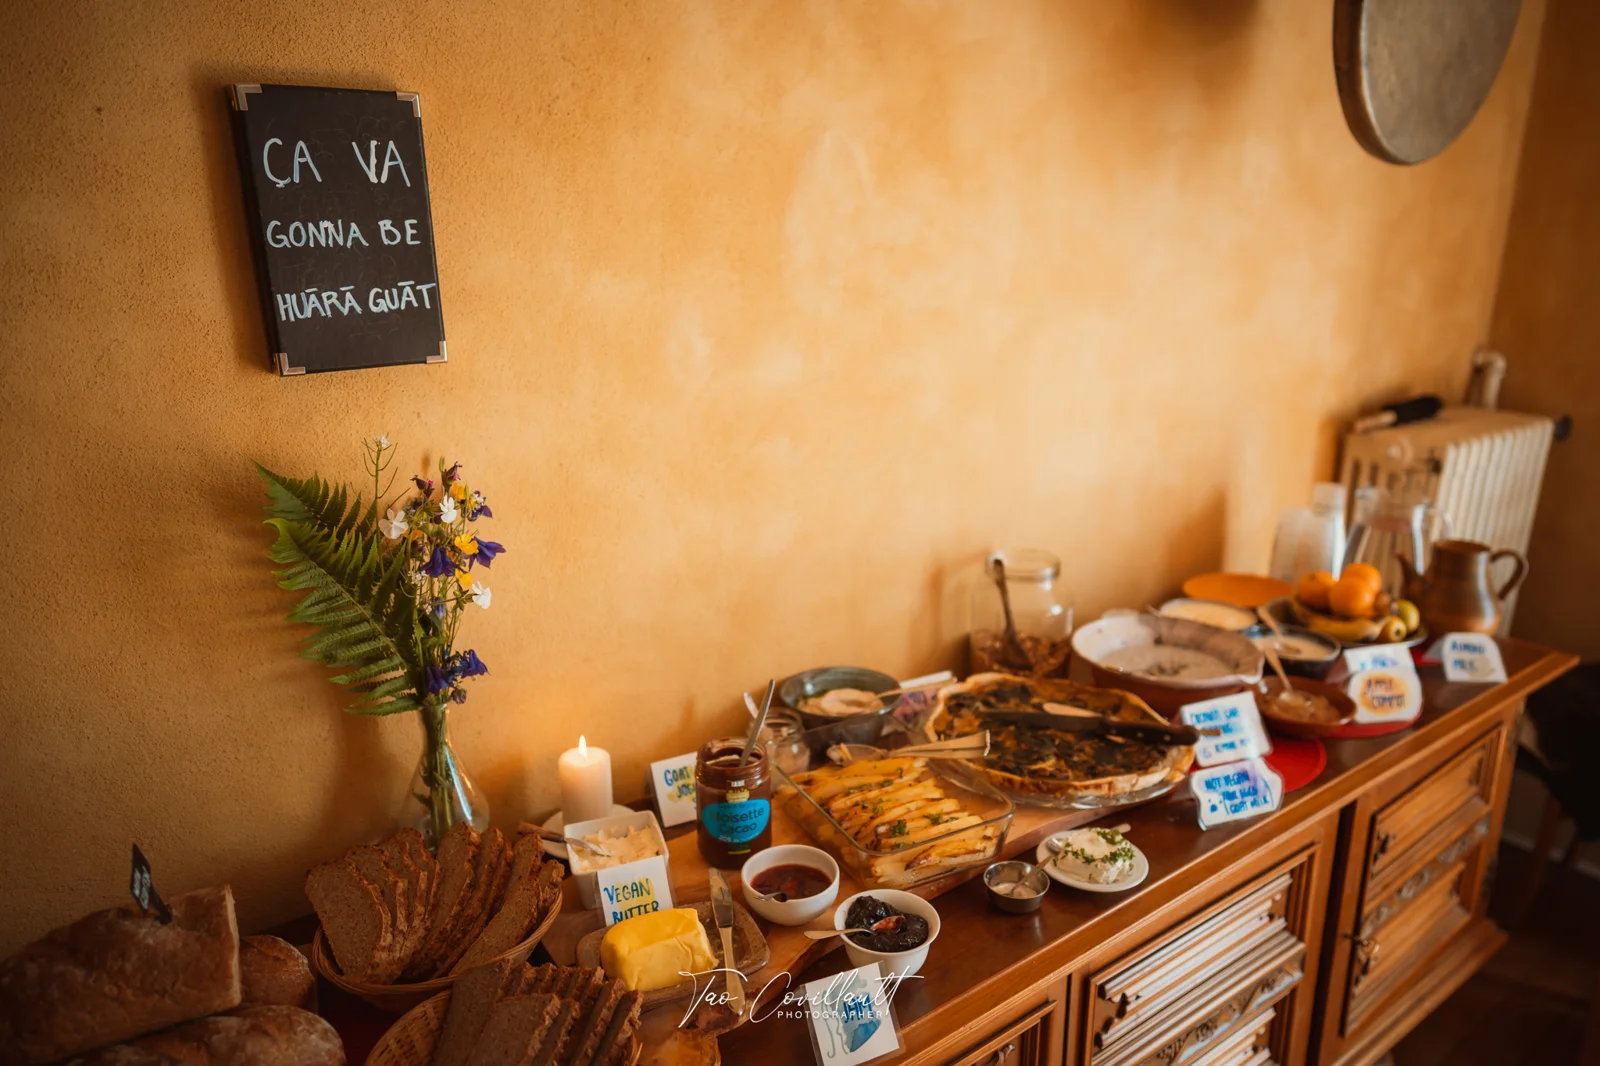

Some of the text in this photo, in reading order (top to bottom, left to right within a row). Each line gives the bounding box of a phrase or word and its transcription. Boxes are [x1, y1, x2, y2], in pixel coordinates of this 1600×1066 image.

[263, 138, 411, 188] ÇA VA
[266, 219, 421, 248] GONNA BE
[664, 766, 690, 787] GOAT
[711, 807, 765, 823] Noisette
[718, 822, 757, 835] Cacao
[603, 878, 650, 905] VEGAN
